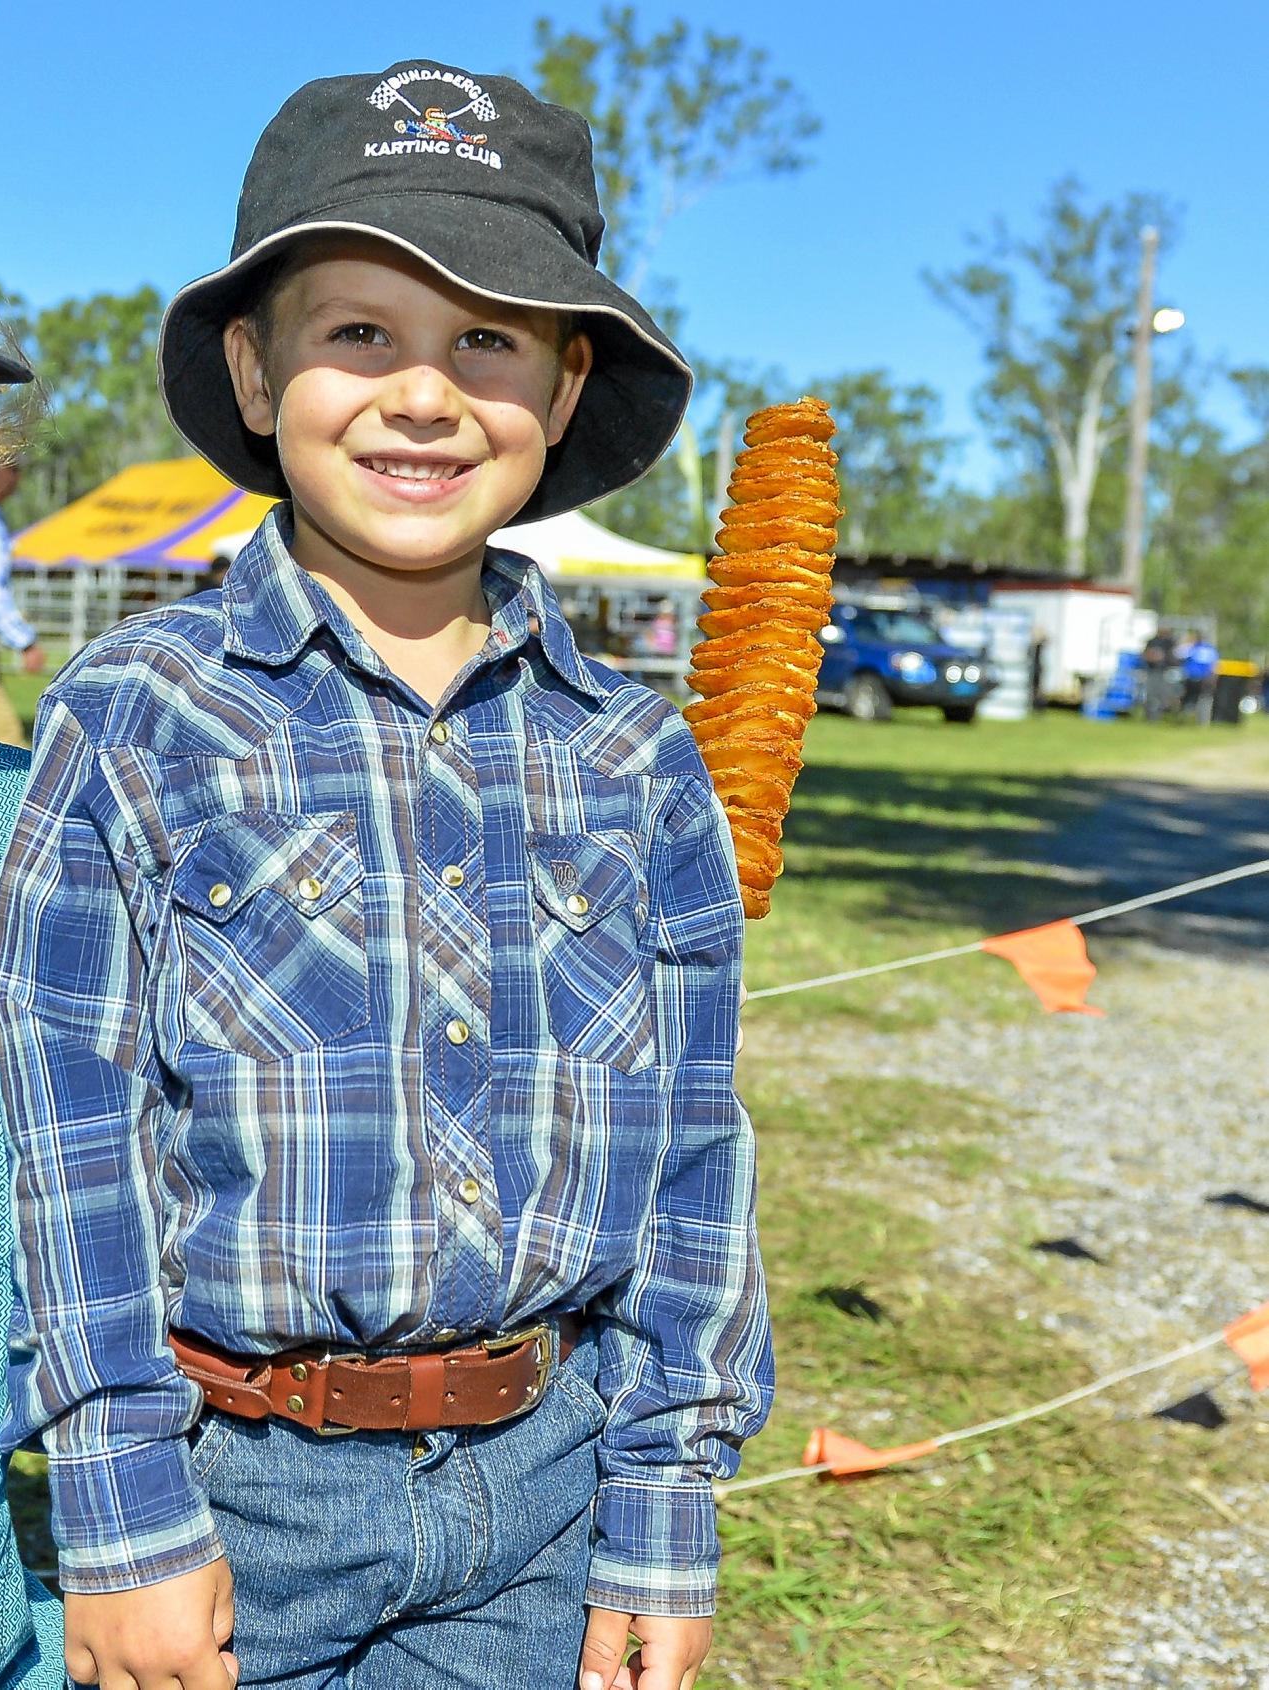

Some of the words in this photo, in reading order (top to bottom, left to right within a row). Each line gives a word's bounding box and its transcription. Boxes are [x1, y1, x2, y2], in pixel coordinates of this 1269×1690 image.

[387, 68, 483, 100] BUNDABERG
[364, 139, 450, 157] KARTING
[455, 142, 502, 170] CLUB
